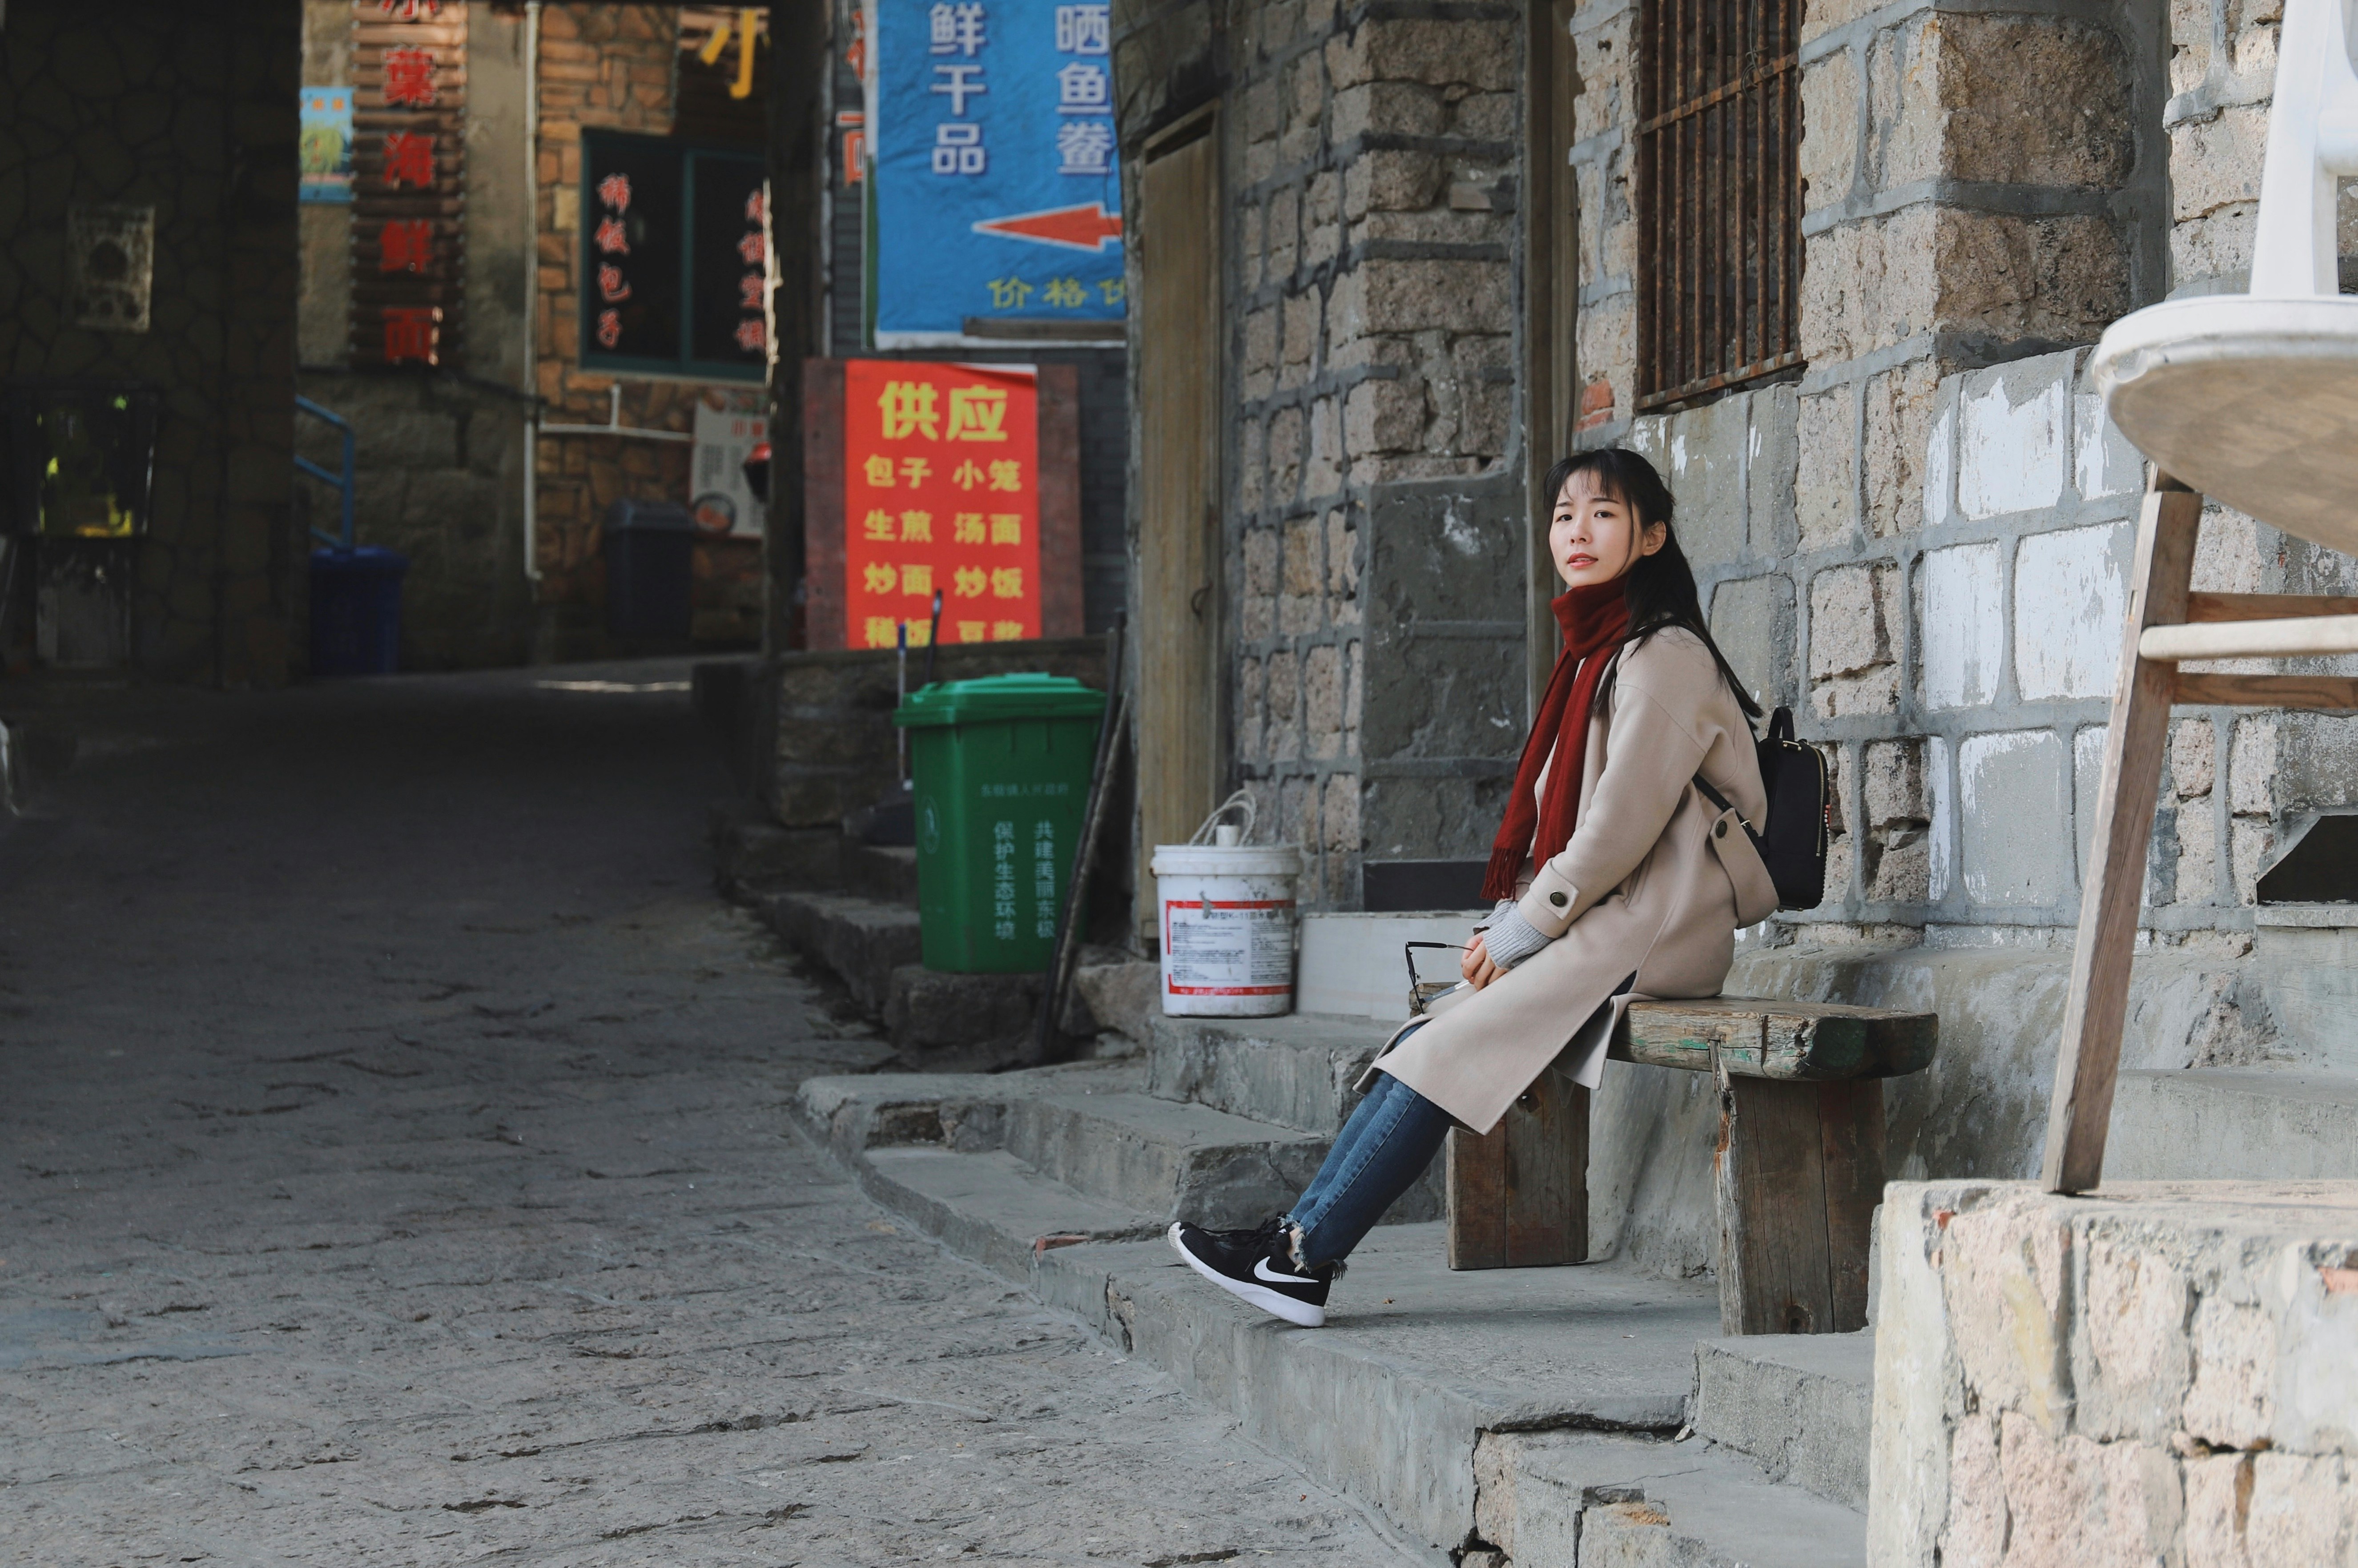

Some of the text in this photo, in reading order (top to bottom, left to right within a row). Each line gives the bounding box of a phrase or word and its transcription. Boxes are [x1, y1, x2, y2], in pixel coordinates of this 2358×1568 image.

[929, 4, 987, 175] 鲜干品
[1055, 4, 1112, 175] 晒鱼鲞
[877, 380, 1008, 442] 供应
[863, 454, 1022, 492] 包子 小笼
[864, 508, 1022, 545] 生煎 汤面
[863, 561, 1023, 598] 炒面 炒饭
[994, 820, 1016, 940] 保护生态环境
[1034, 820, 1055, 939] 共建美丽东极
